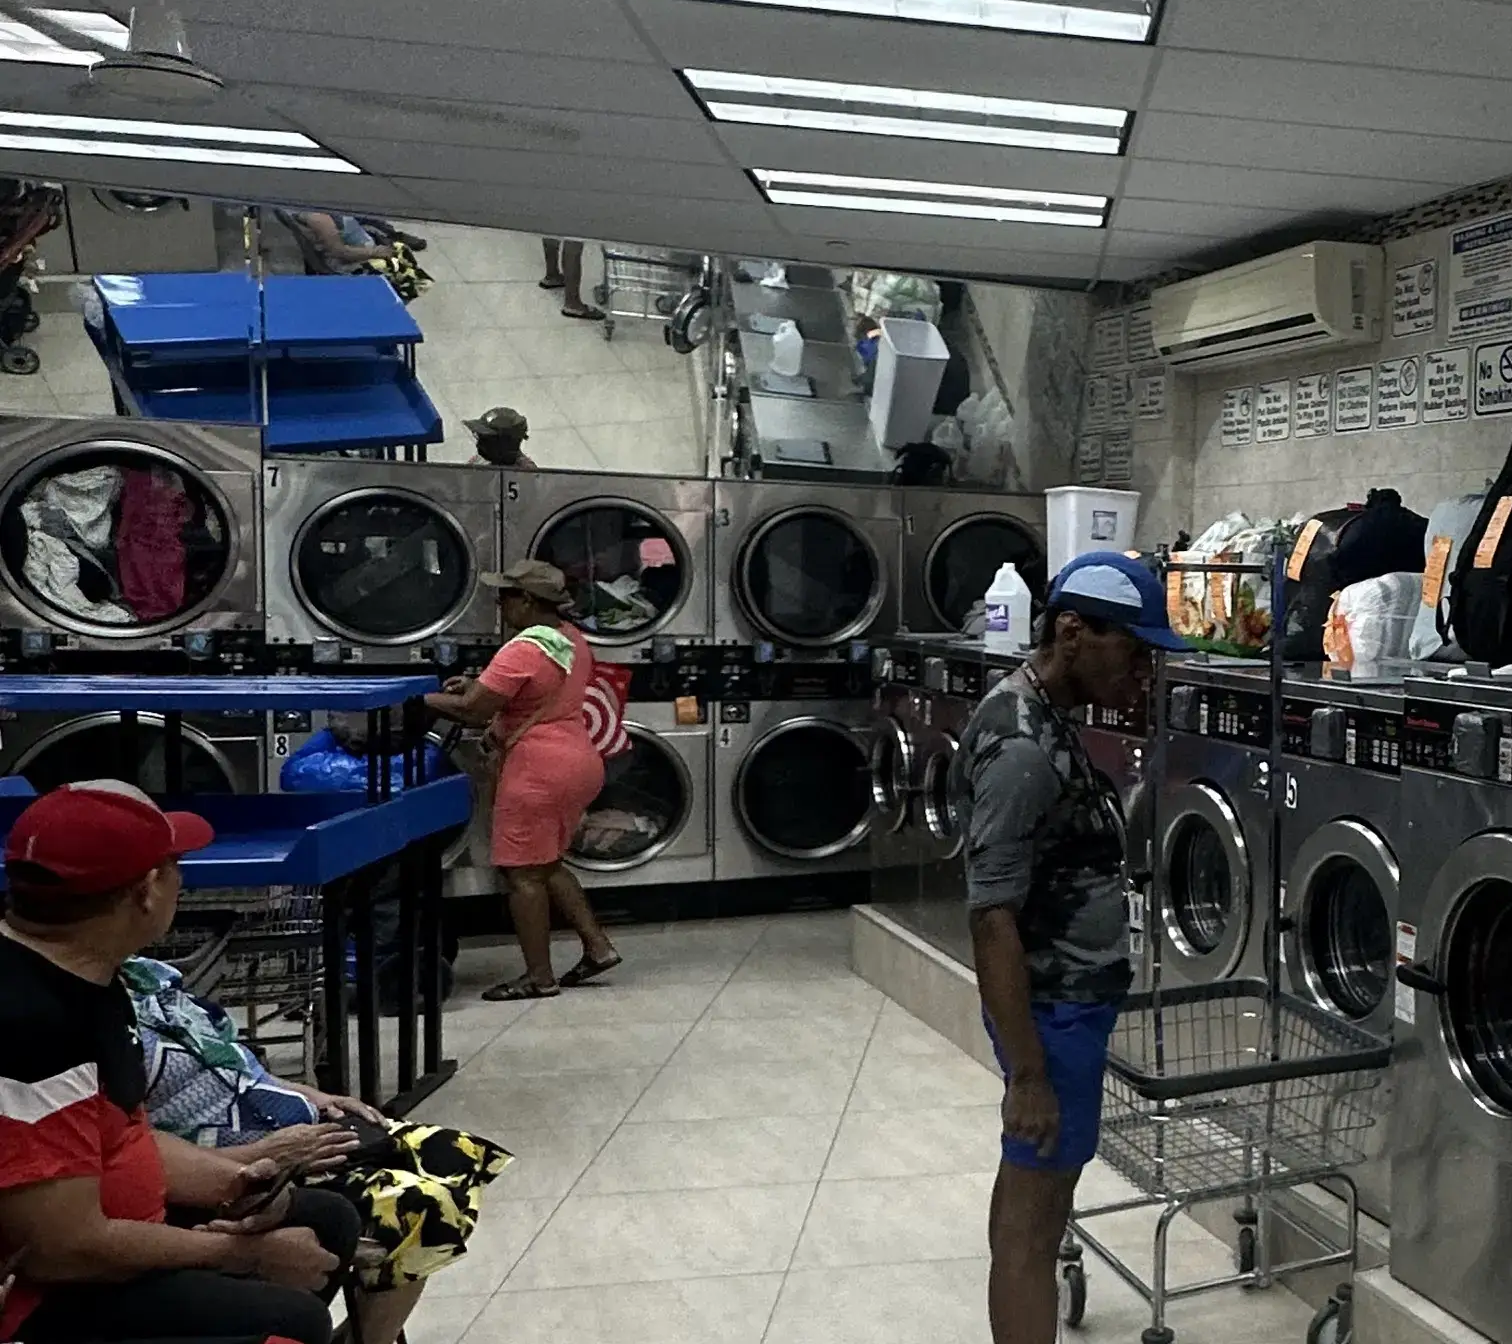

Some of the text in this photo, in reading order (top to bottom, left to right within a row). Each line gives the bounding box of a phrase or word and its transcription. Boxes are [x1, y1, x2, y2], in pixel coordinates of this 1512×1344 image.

[1479, 360, 1492, 380] No
[267, 467, 279, 487] 7
[508, 482, 518, 501] 5
[276, 735, 287, 756] 8
[720, 728, 729, 746] 4
